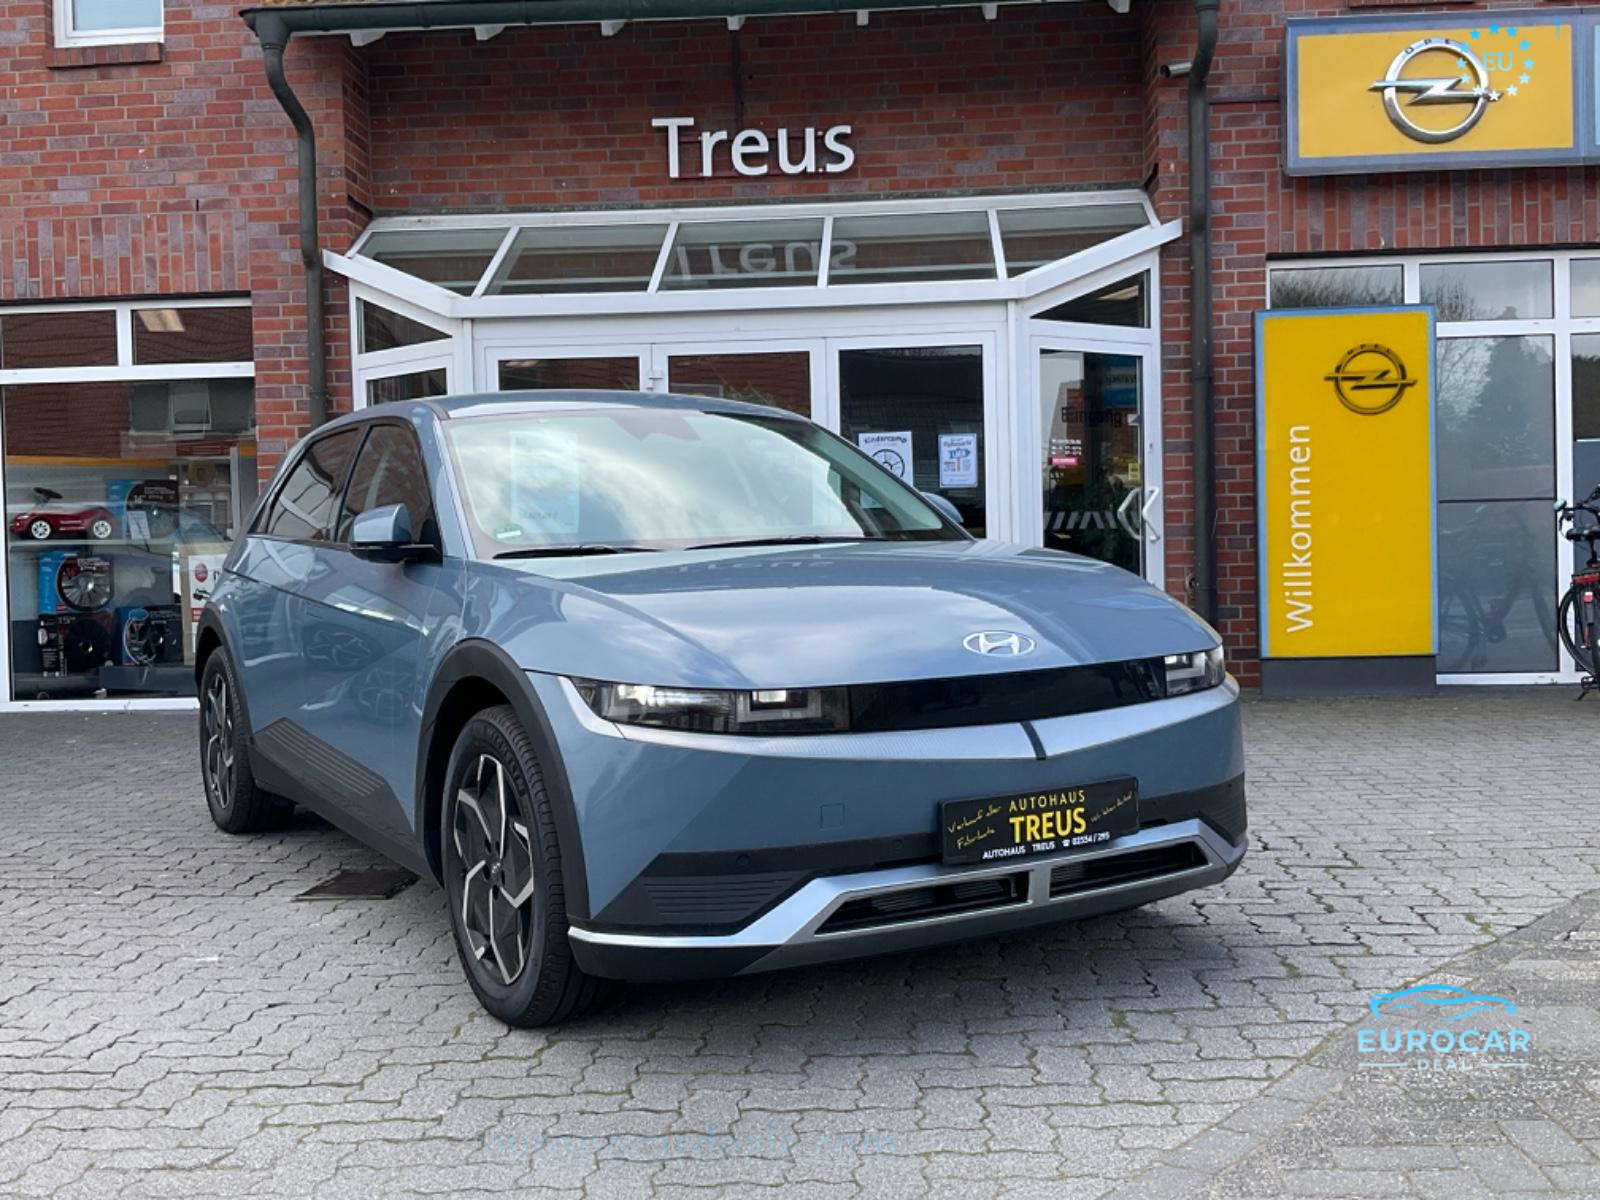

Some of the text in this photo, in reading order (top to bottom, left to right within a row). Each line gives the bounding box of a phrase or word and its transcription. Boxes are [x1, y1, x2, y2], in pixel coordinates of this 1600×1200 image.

[651, 117, 855, 178] Treus
[1283, 425, 1313, 633] Willkommen
[1009, 789, 1085, 812] AUTOHAUS
[1009, 807, 1087, 844] TREUS
[982, 845, 1026, 860] AUTOHAUS
[1032, 841, 1055, 852] TREUS
